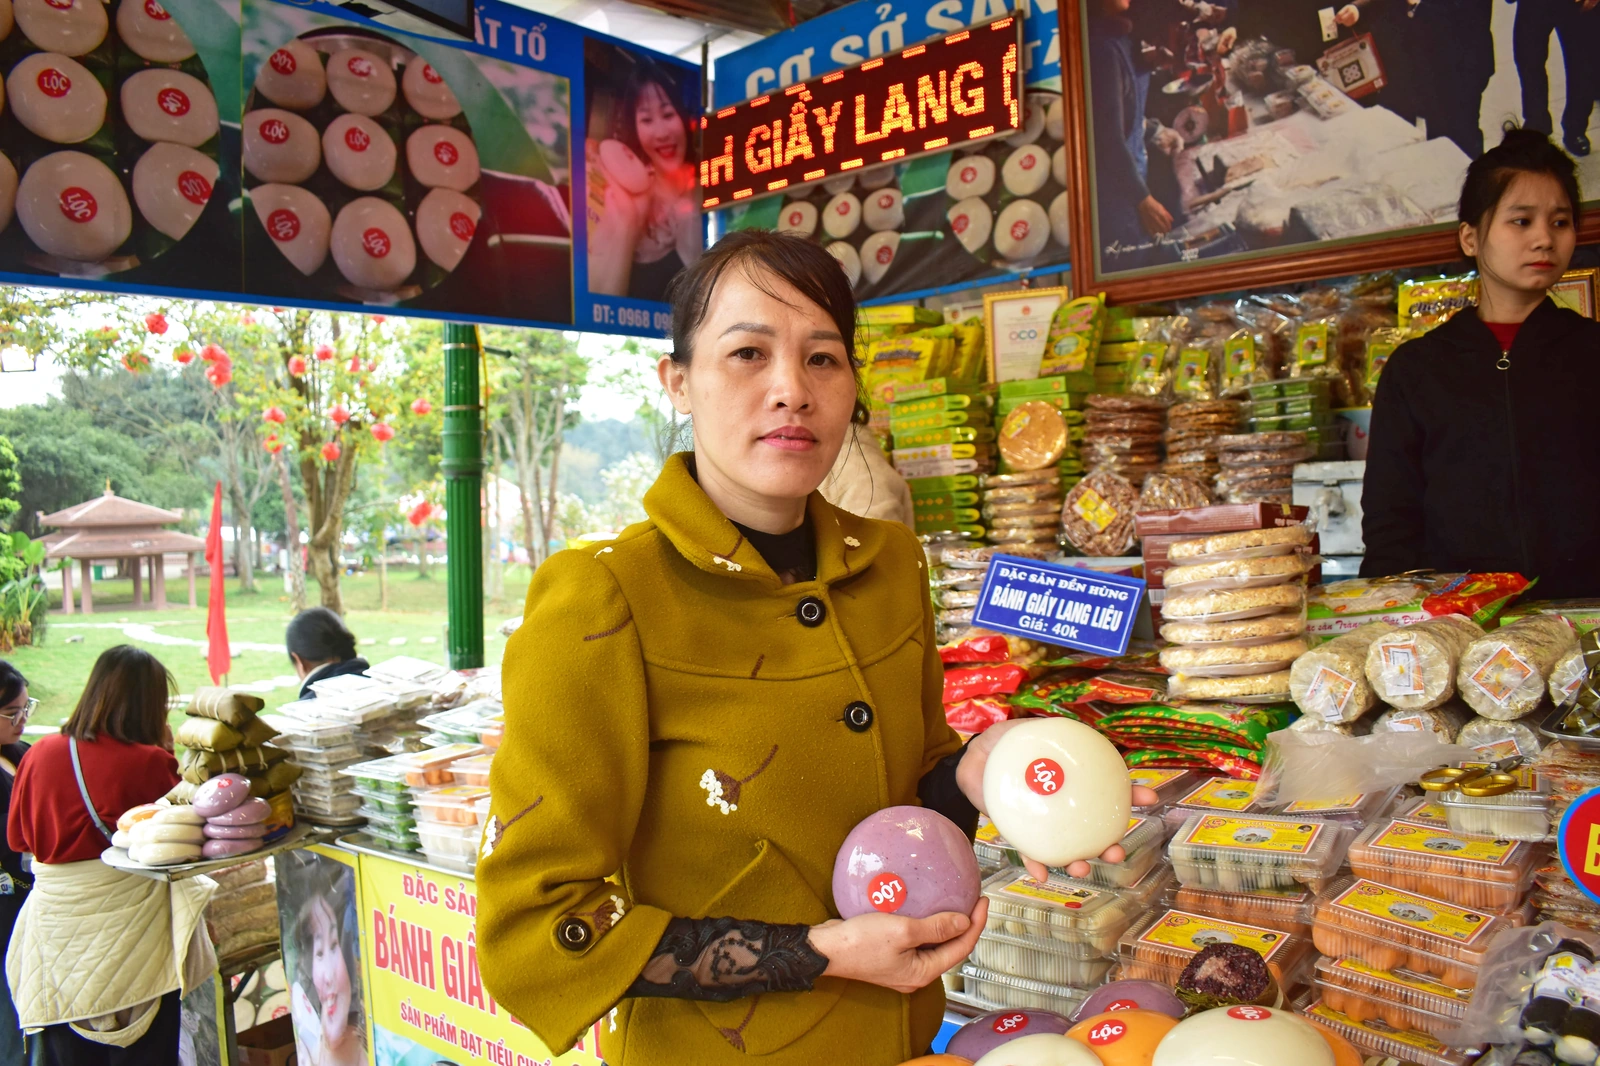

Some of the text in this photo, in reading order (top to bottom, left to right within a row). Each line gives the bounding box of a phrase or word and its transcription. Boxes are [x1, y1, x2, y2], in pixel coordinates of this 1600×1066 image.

[510, 22, 548, 61] TỔ
[43, 71, 68, 94] LỘC
[855, 61, 984, 145] LANG
[593, 303, 615, 324] ĐT:
[618, 306, 650, 328] 0968
[999, 567, 1026, 581] ĐẶC
[1028, 572, 1057, 587] SẢN
[1088, 585, 1129, 601] HÙNG
[989, 583, 1027, 611] BÁNH
[1055, 598, 1092, 625] LANG
[1090, 604, 1124, 632] LIÊU
[1018, 615, 1080, 639] Giá: 40k
[1033, 761, 1057, 793] LỘC
[403, 870, 439, 905] ĐẶC
[871, 879, 903, 905] LỘC
[374, 904, 436, 991] BÁNH
[400, 997, 422, 1029] SẢN
[424, 1013, 458, 1045] PHẨM
[460, 1029, 483, 1057] ĐẠT
[996, 1013, 1024, 1032] LỘC
[1090, 1023, 1124, 1041] LỘC
